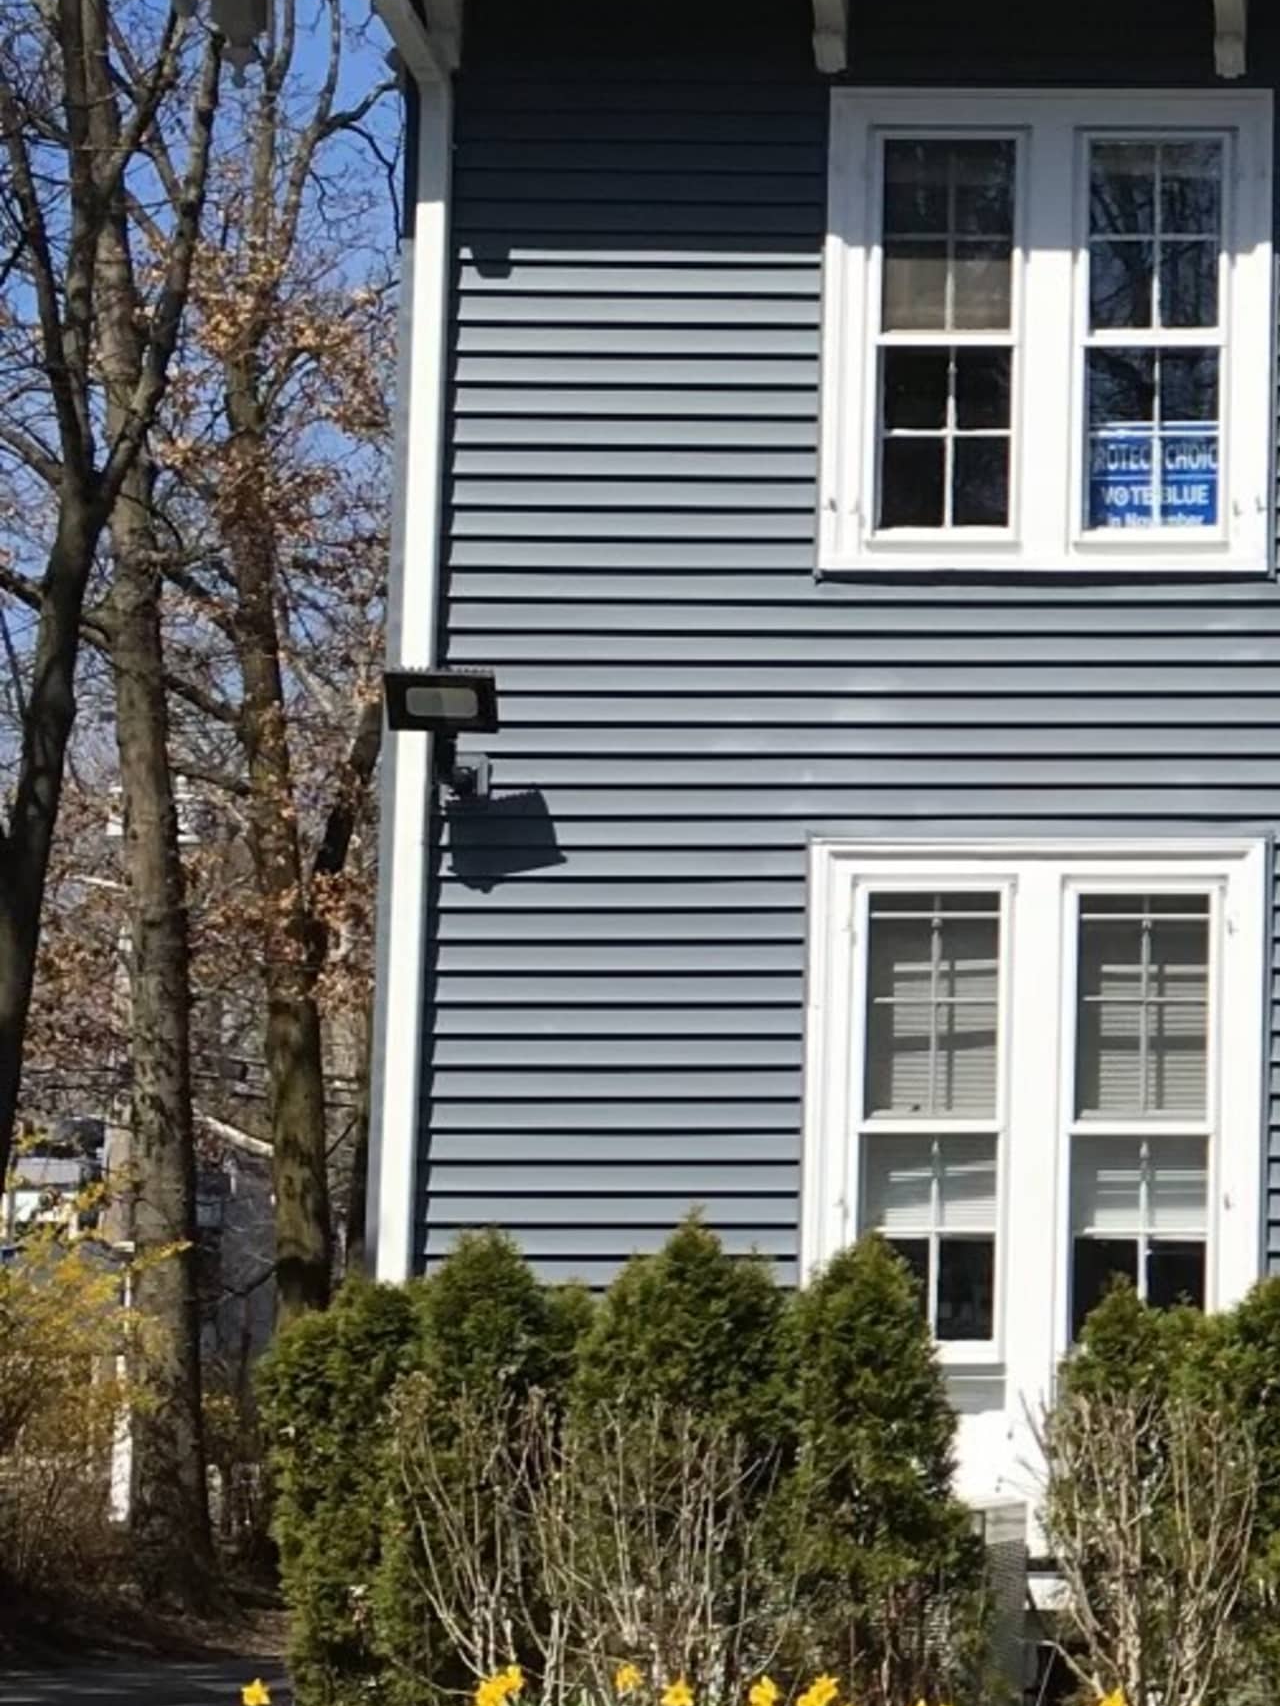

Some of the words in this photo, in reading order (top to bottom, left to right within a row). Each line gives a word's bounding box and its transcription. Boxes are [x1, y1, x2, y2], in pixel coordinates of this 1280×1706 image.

[1165, 443, 1218, 470] CHOIC
[1102, 485, 1153, 507] VOTE
[1159, 484, 1210, 506] BLUE
